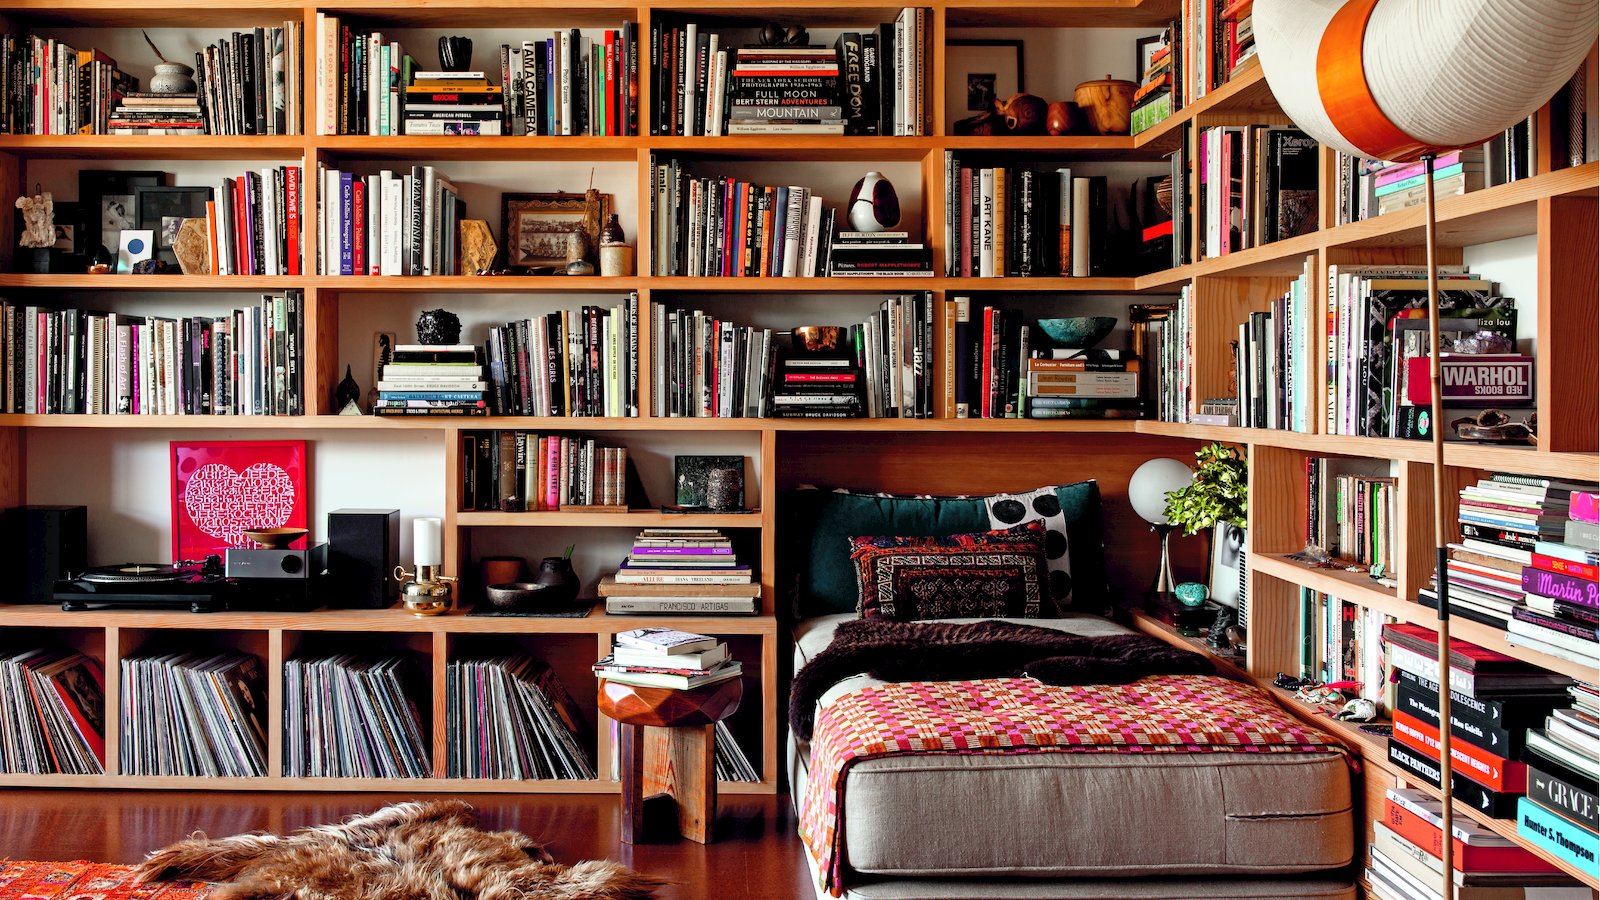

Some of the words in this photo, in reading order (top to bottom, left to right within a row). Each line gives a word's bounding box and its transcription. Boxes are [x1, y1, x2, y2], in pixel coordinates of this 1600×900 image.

[525, 49, 534, 69] AM
[845, 41, 862, 119] FREEDOM
[525, 80, 536, 134] CAMERA
[756, 108, 819, 118] MOUNTAIN
[659, 169, 667, 194] male
[1496, 318, 1510, 326] lou
[120, 366, 127, 375] of
[913, 347, 923, 377] Jazz
[1442, 366, 1527, 386] WARHOL
[517, 433, 526, 464] Haywire
[1539, 573, 1584, 603] Martin
[1449, 691, 1486, 714] DOLESCENCE
[1547, 780, 1594, 819] GRACE
[1524, 815, 1548, 838] Hunter
[1556, 831, 1595, 863] Thompson
